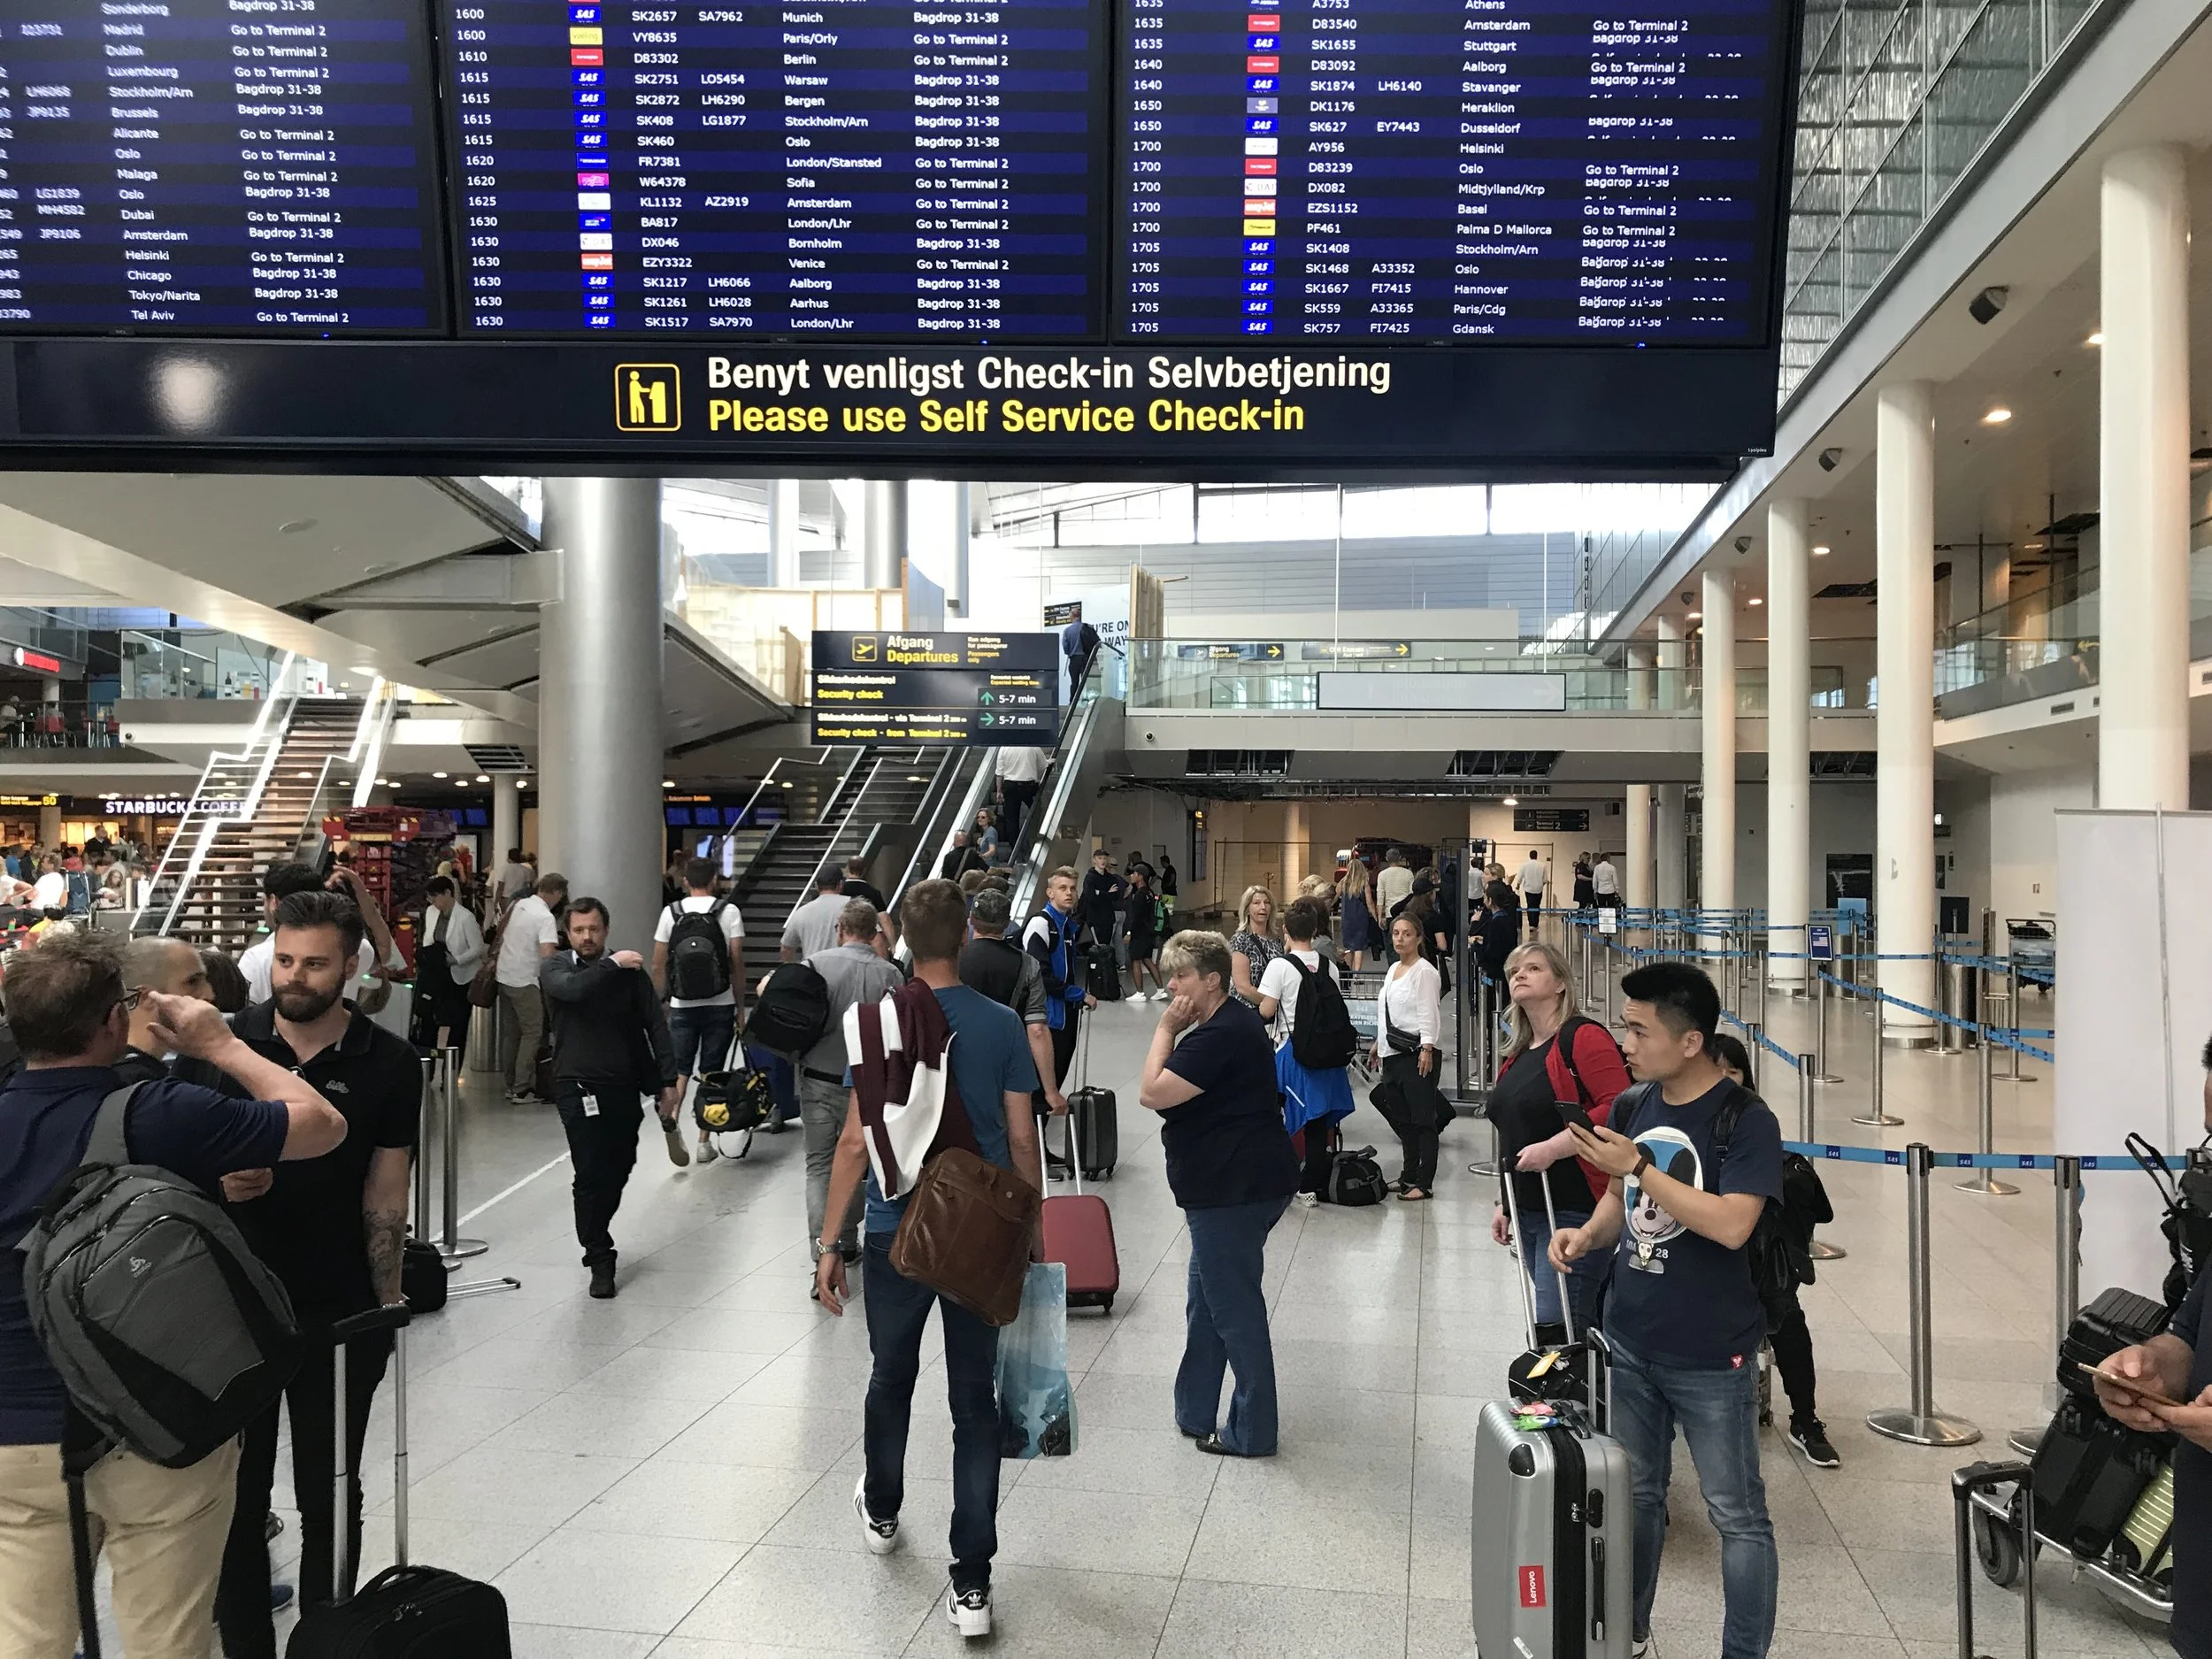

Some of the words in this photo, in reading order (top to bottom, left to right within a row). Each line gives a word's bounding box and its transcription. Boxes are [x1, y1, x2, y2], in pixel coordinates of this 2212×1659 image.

[457, 9, 484, 19] 1600
[575, 9, 595, 19] SAS
[632, 11, 677, 21] SK2657
[699, 12, 742, 21] SA7962
[783, 12, 823, 22] Munich
[914, 12, 961, 25] Bagdrop
[965, 12, 999, 23] 31-38
[1135, 18, 1163, 28] 1635
[1312, 19, 1356, 29] D83540
[1464, 20, 1530, 30] Amsterdam
[104, 24, 144, 36] Madrid
[633, 32, 677, 42] VY8635
[783, 34, 838, 45] Paris/Orly
[105, 44, 144, 57] Dublin
[1464, 41, 1517, 53] Stuttgart
[634, 53, 679, 64] D83302
[784, 54, 816, 64] Berlin
[107, 65, 179, 79] Luxembourg
[1311, 60, 1356, 71] D83092
[1591, 62, 1607, 73] Go
[1611, 63, 1622, 73] to
[1626, 62, 1674, 73] Terminal
[1678, 63, 1685, 73] 2
[635, 74, 679, 84] SK2751
[702, 74, 745, 84] LO5454
[784, 75, 828, 85] Warsaw
[109, 86, 193, 98] Stockholm/Arn
[1463, 82, 1521, 94] Stavanger
[785, 96, 825, 108] Bergen
[1310, 101, 1355, 111] DK1176
[1462, 103, 1515, 112] Heraklion
[111, 107, 159, 119] Brussels
[464, 114, 491, 124] 1615
[637, 116, 673, 126] SK408
[703, 116, 746, 126] LG1877
[113, 127, 159, 138] Alicante
[1377, 122, 1419, 132] EY7443
[1461, 123, 1521, 133] Dusseldorf
[639, 157, 680, 166] FR7381
[787, 157, 881, 169] London/Stansted
[916, 158, 932, 168] Go
[935, 158, 947, 168] to
[949, 158, 997, 168] Terminal
[1002, 158, 1009, 168] 2
[1309, 163, 1353, 173] D83239
[117, 169, 157, 181] Malaga
[640, 177, 686, 187] W64378
[787, 178, 815, 188] Sofia
[36, 188, 81, 199] LG1839
[119, 189, 144, 199] Oslo
[1459, 184, 1545, 196] Midtjylland/Krp
[641, 197, 682, 207] KL1132
[705, 196, 749, 206] AZ2919
[120, 210, 154, 219] Dubai
[1308, 204, 1357, 213] EZS1152
[1458, 204, 1487, 214] Basel
[641, 218, 678, 227] BA817
[788, 219, 851, 229] London/Lhr
[1308, 223, 1340, 233] PF461
[1457, 224, 1489, 234] Palma
[1494, 225, 1502, 234] D
[1507, 225, 1552, 234] Mallorca
[40, 229, 81, 240] JP9106
[124, 230, 188, 241] Amsterdam
[642, 238, 679, 247] DX046
[789, 238, 841, 248] Bornholm
[126, 250, 169, 260] Helsinki
[643, 257, 692, 267] EZY3322
[788, 258, 826, 268] Venice
[1372, 264, 1415, 273] A33352
[127, 271, 172, 282] Chicago
[643, 278, 687, 287] SK1217
[789, 279, 832, 290] Aalborg
[1455, 285, 1509, 294] Hannover
[129, 290, 200, 302] Tokyo/Narita
[255, 288, 302, 300] Bagdrop
[305, 288, 338, 298] 31-38
[644, 297, 687, 307] SK1261
[709, 297, 751, 307] LH6028
[790, 298, 829, 308] Aarhus
[1454, 304, 1506, 316] Paris/Cdg
[132, 311, 149, 319] Tel
[152, 311, 174, 319] Aviv
[257, 312, 273, 321] Go
[276, 313, 288, 322] to
[290, 312, 338, 322] Terminal
[342, 313, 349, 322] 2
[476, 317, 503, 326] 1630
[590, 316, 610, 325] SAS
[645, 318, 688, 326] SK1517
[710, 318, 752, 326] SA7970
[791, 319, 854, 329] London/Lhr
[1132, 323, 1158, 332] 1705
[1304, 324, 1340, 333] SK757
[1371, 324, 1409, 333] FI7425
[1453, 324, 1494, 334] Gdansk
[709, 357, 810, 396] Benyt
[823, 357, 964, 396] venligst
[979, 357, 1133, 389] Check-in
[1148, 356, 1391, 396] Selvbetjening
[709, 400, 829, 432] Please
[843, 408, 906, 432] use
[919, 400, 988, 432] Self
[1002, 400, 1134, 432] Service
[1148, 399, 1304, 432] Check-in
[887, 635, 934, 650] Afgang
[887, 650, 959, 664] Departures
[818, 689, 855, 701] Security
[856, 689, 884, 699] check
[999, 695, 1016, 703] 5-7
[1018, 695, 1036, 703] min
[909, 713, 942, 722] Terminal
[943, 713, 950, 722] 2
[999, 716, 1016, 725] 5-7
[1018, 716, 1036, 725] min
[818, 727, 851, 738] Security
[852, 728, 878, 737] check
[886, 728, 905, 737] from
[909, 728, 942, 737] Terminal
[943, 728, 950, 737] 2
[42, 795, 57, 806] 50
[105, 801, 196, 814] STARBUCK
[1655, 1248, 1669, 1259] 28
[1529, 1571, 1538, 1603] Lenovo
